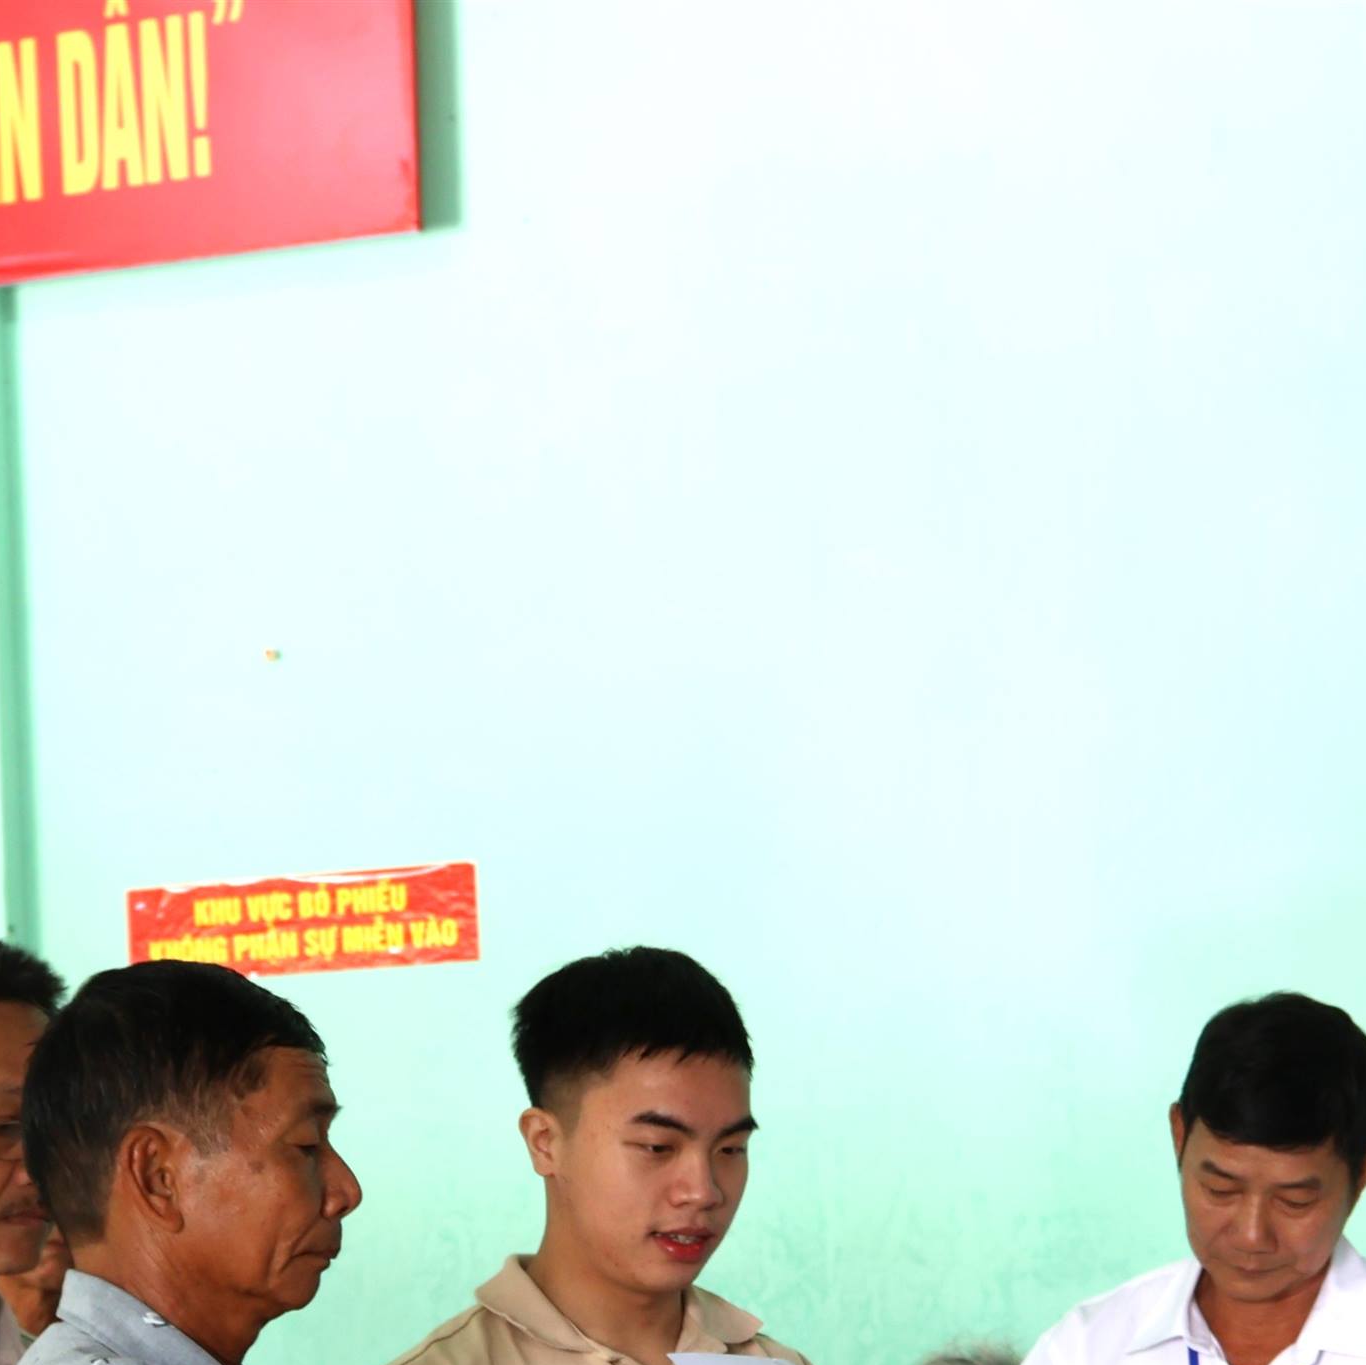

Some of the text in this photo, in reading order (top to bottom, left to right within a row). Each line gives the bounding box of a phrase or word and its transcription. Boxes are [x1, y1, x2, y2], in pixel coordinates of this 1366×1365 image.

[193, 895, 240, 927] KHU
[246, 889, 291, 922] VỰC
[409, 914, 458, 947] VÀO
